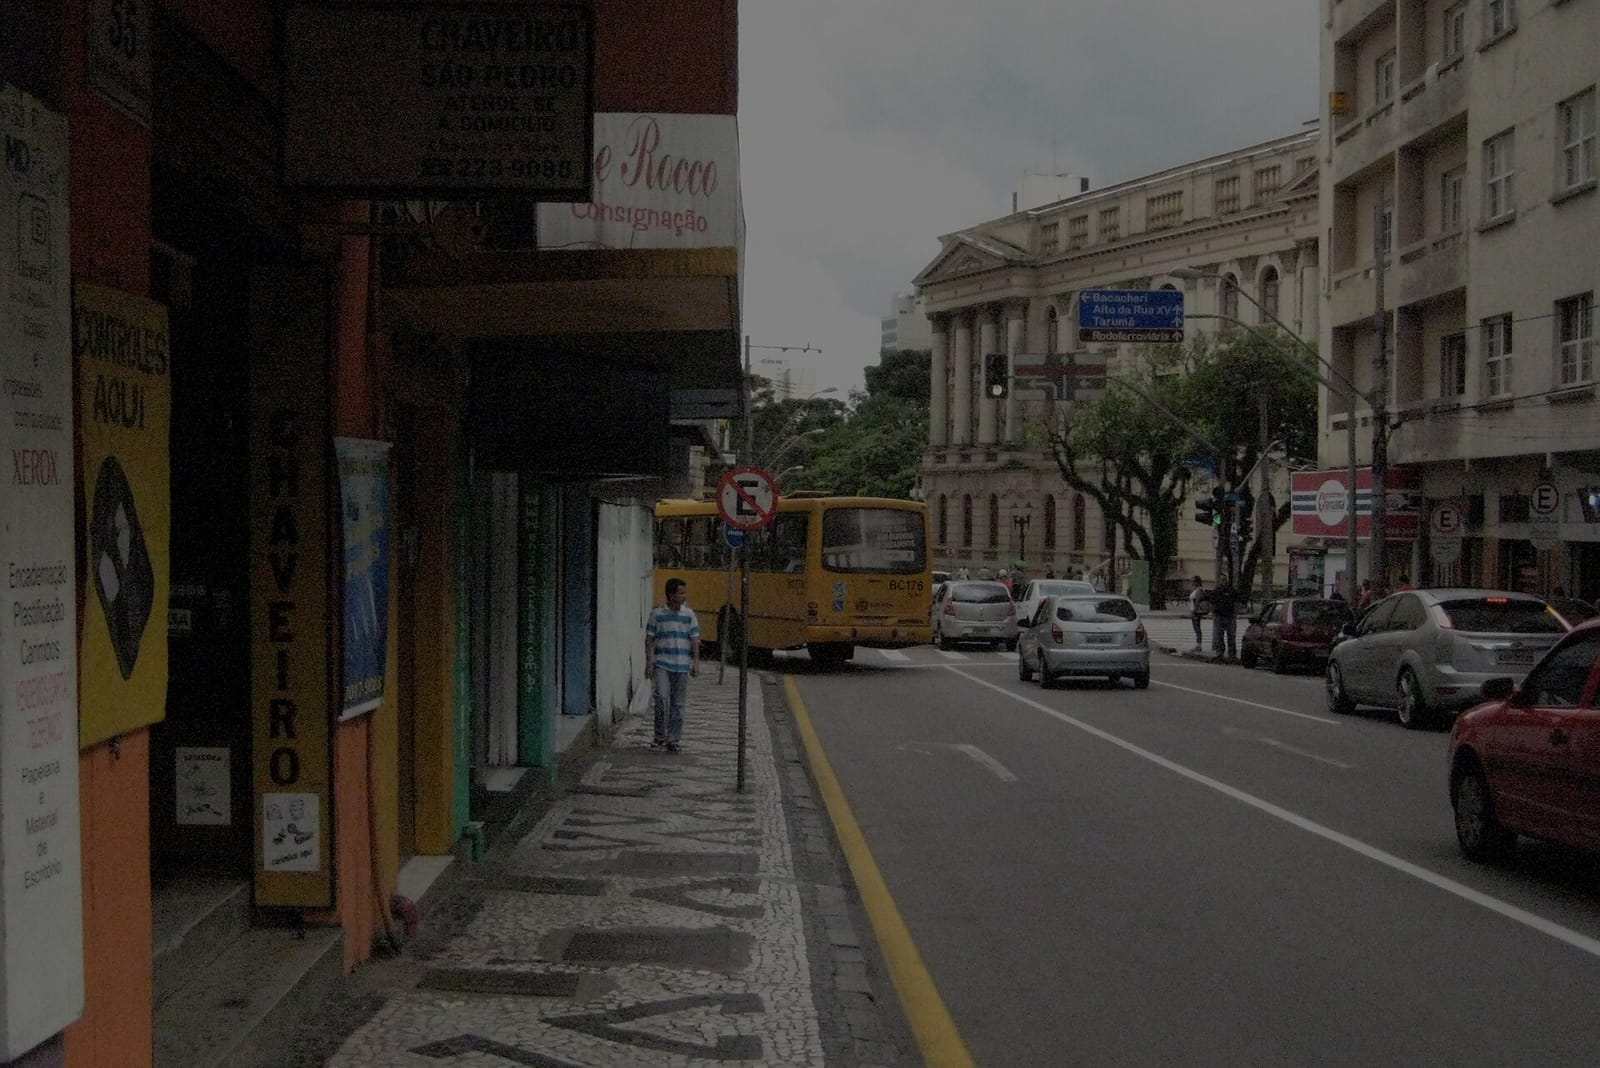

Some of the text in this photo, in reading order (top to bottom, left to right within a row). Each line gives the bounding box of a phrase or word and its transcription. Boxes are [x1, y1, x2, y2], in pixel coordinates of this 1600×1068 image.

[420, 19, 578, 52] CHAVEIRO
[484, 64, 578, 89] PEDRO
[620, 115, 718, 197] Rocco
[571, 200, 708, 236] Consignação
[1092, 293, 1148, 303] Bacacheri
[1092, 304, 1115, 315] Alto
[1133, 304, 1155, 315] Rua
[1156, 304, 1172, 315] XV
[93, 373, 145, 431] AQUI
[12, 448, 60, 486] XEROX
[1538, 488, 1552, 509] E
[1439, 510, 1452, 528] E
[267, 408, 301, 787] CHAVEIRO
[888, 578, 924, 592] BC176
[25, 808, 59, 836] Material
